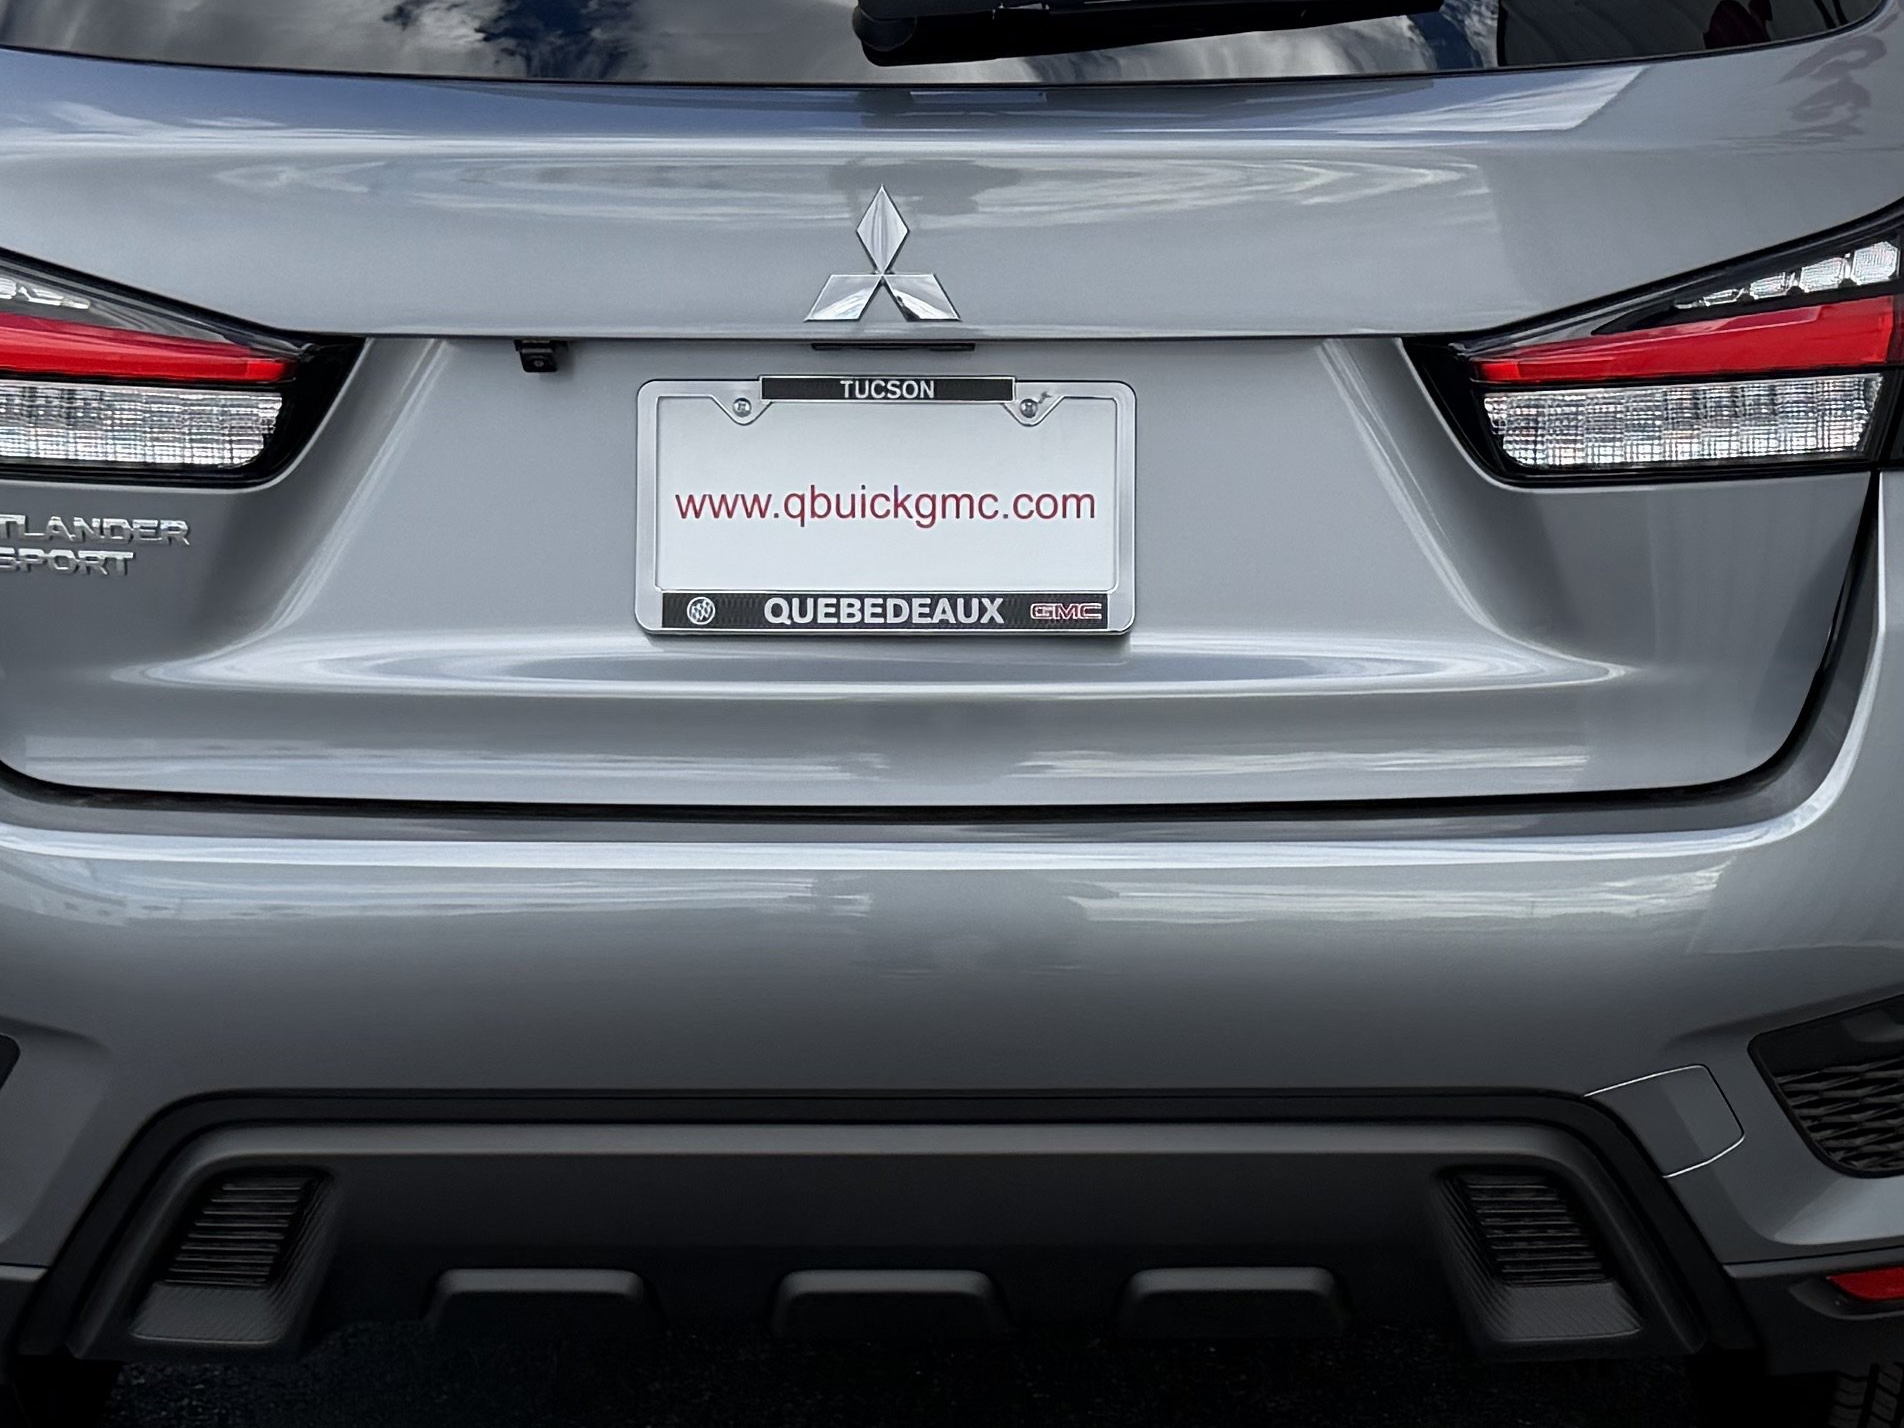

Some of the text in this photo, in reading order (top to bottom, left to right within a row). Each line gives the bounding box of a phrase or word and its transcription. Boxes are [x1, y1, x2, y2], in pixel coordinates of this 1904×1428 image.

[839, 379, 936, 400] TUCSON
[674, 483, 1096, 529] www.qbuickgmc.com
[763, 597, 1103, 626] QUEBEDEAUX GMC
